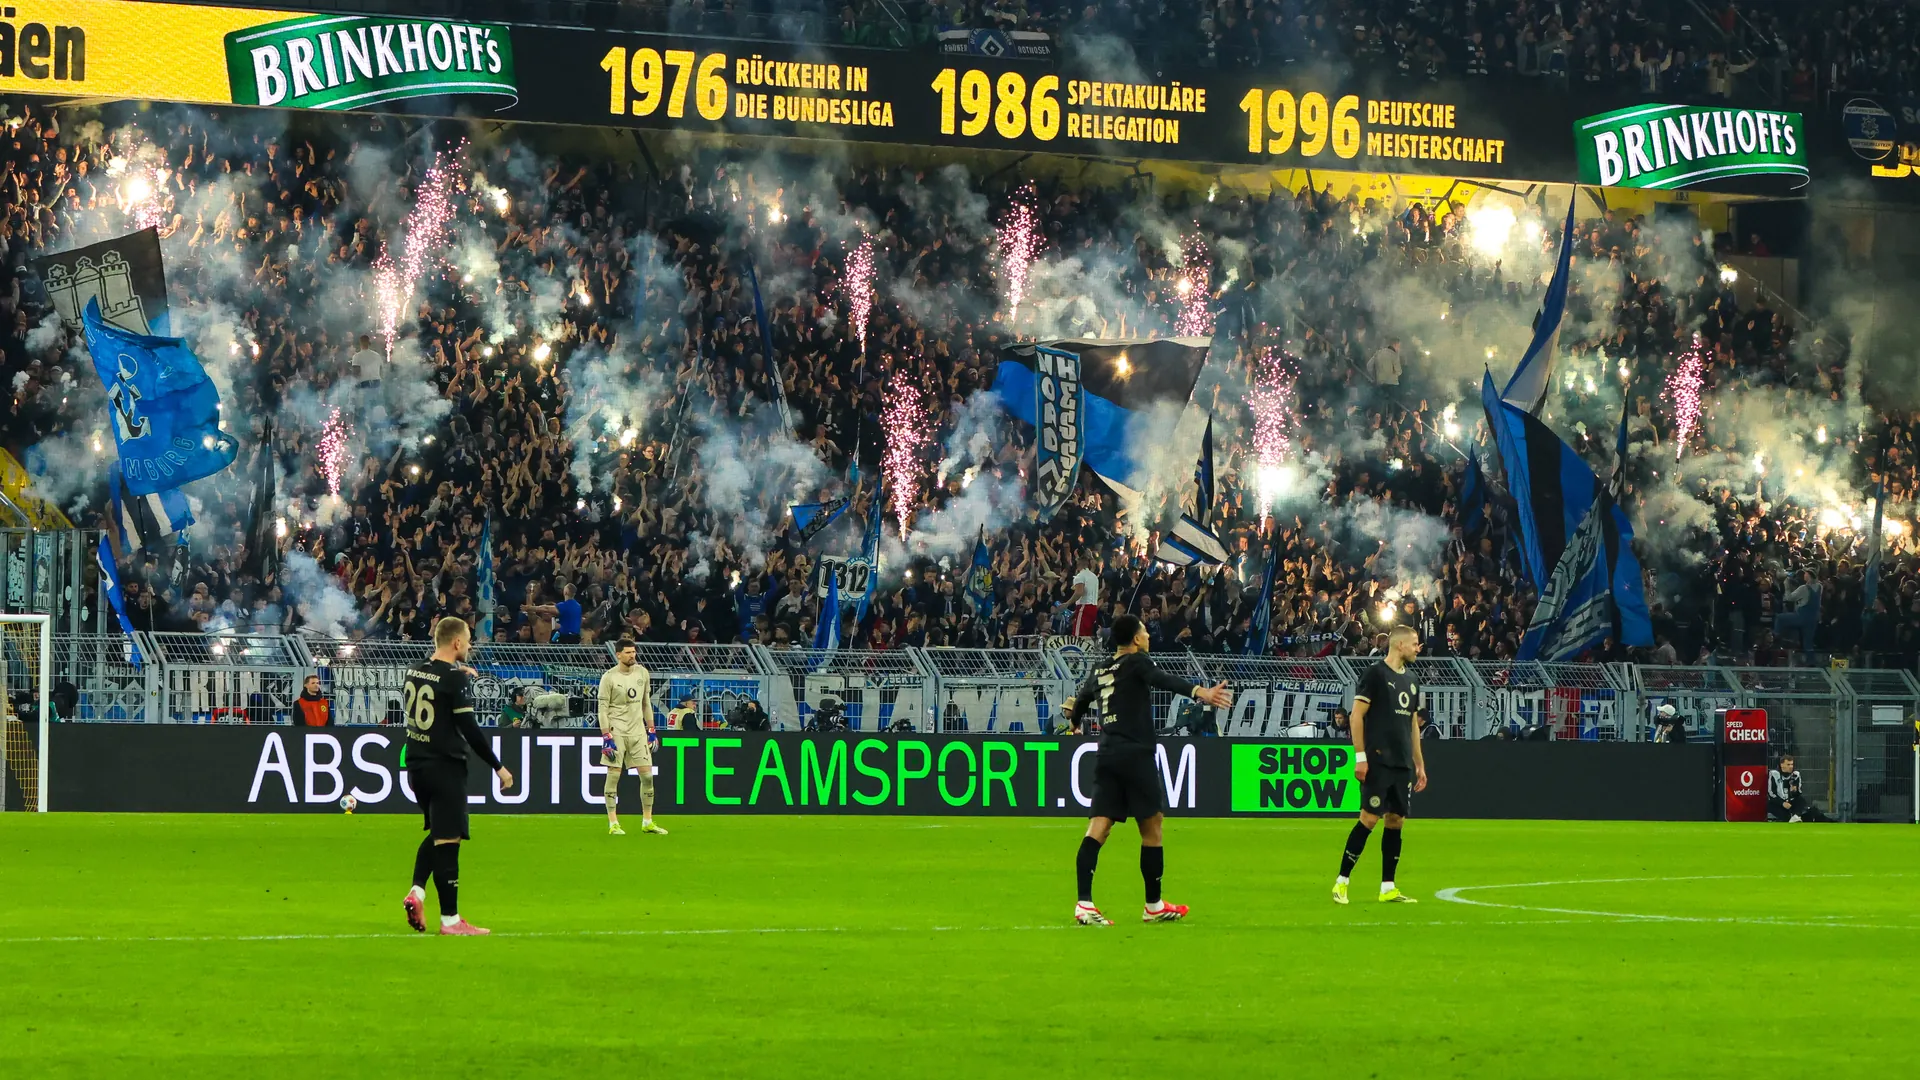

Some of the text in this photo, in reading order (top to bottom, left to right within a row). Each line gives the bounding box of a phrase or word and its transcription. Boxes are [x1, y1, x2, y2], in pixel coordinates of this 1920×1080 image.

[600, 46, 868, 121] 1976 RÜCKKEHR IN
[735, 93, 893, 127] DIE BUNDESLIGA
[931, 69, 1206, 141] 1986 SPEKTAKULÄRE
[1067, 112, 1179, 144] RELEGATION
[1239, 88, 1455, 159] 1996 DEUTSCHE
[1366, 131, 1505, 164] MEISTERSCHAFT
[125, 437, 195, 481] MBURG
[1048, 632, 1084, 650] EKTION
[404, 680, 435, 731] 26
[1097, 673, 1115, 714] 7
[1726, 721, 1743, 729] SPEED
[1729, 729, 1765, 741] CHECK
[248, 731, 1196, 809] ABSUTE-TEAMSPORT.CM
[1258, 746, 1349, 775] SHOP
[1259, 779, 1348, 809] NOW
[1733, 786, 1760, 796] vodafone
